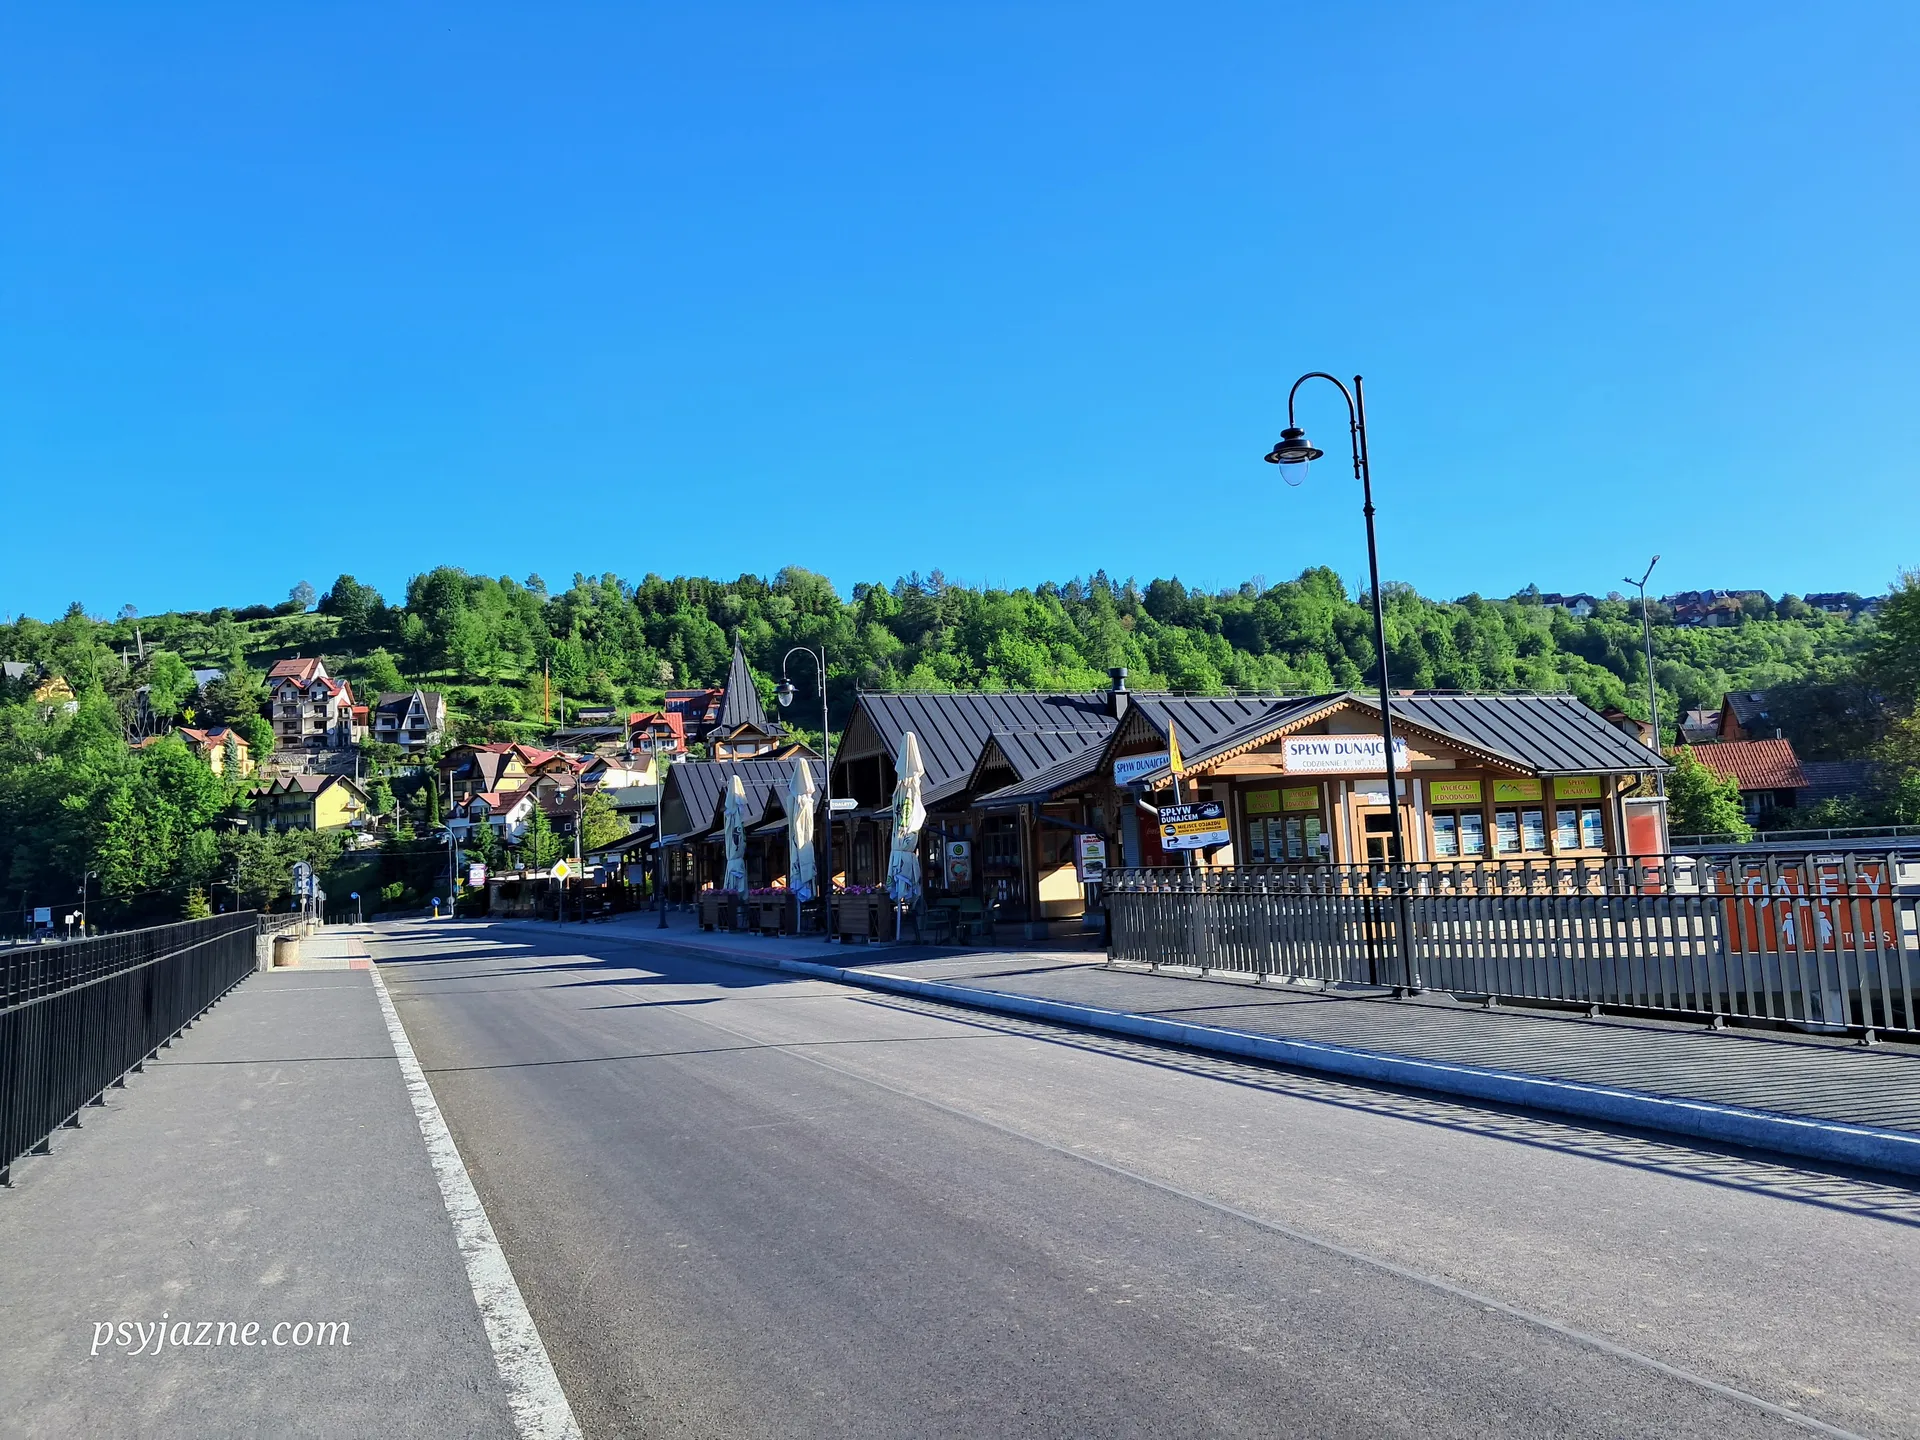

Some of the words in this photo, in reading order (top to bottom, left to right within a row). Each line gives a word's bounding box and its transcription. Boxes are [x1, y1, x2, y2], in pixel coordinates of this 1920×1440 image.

[1290, 743, 1330, 755] SPŁYW
[1335, 742, 1401, 756] DUNAJCM
[1160, 806, 1191, 817] SPŁYW
[1161, 813, 1198, 823] DUNAJCEM
[1732, 872, 1883, 908] OALEY
